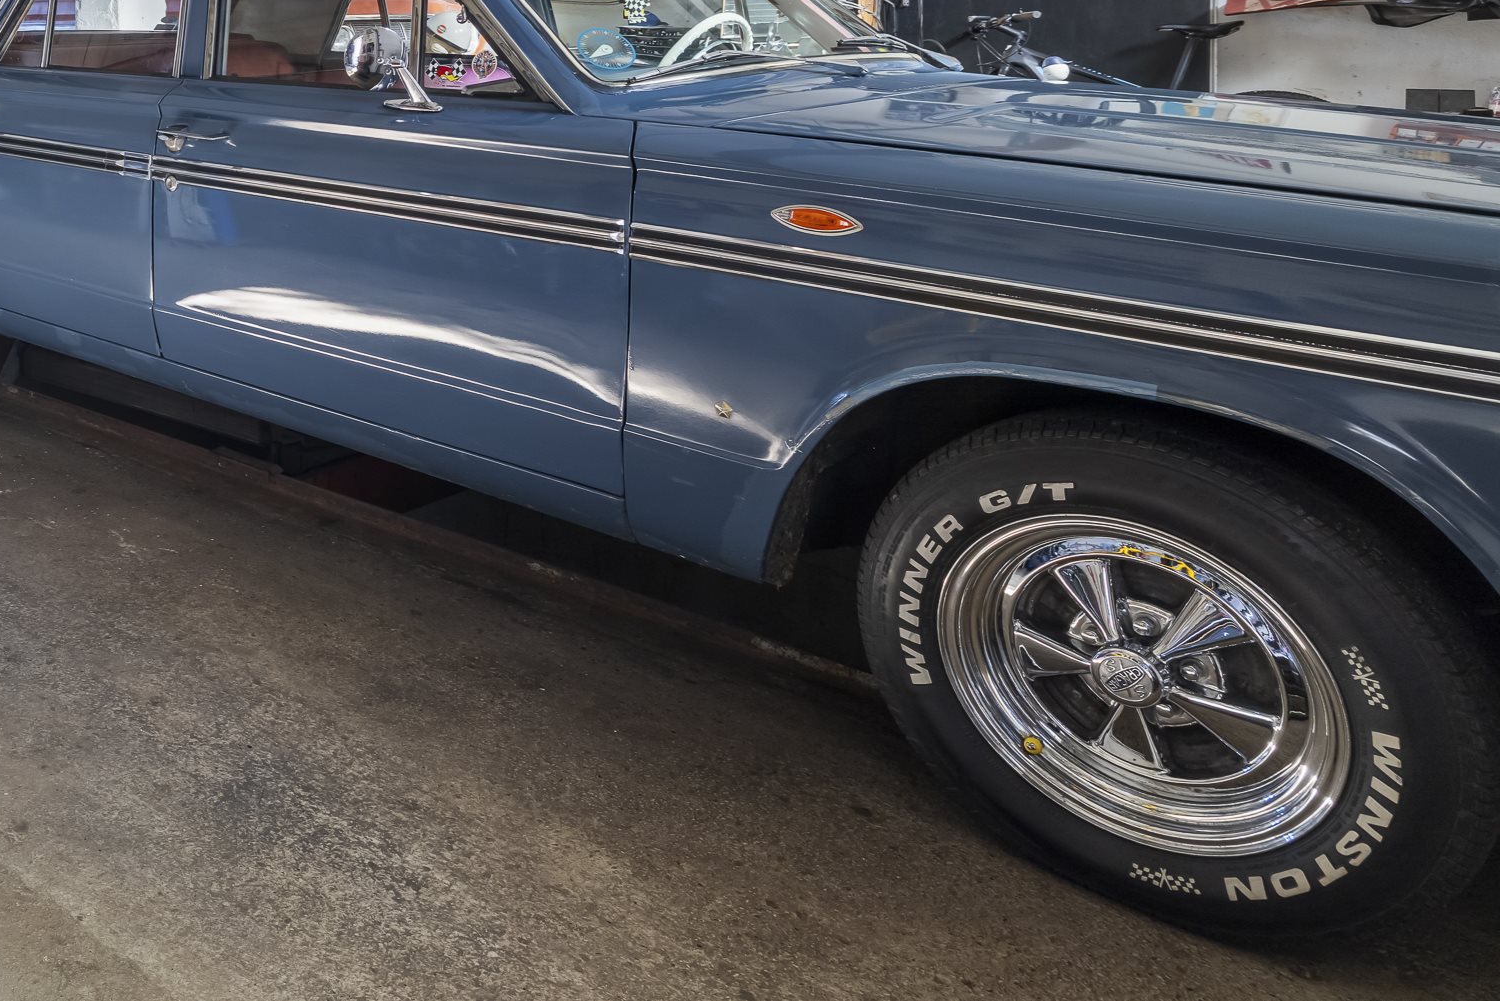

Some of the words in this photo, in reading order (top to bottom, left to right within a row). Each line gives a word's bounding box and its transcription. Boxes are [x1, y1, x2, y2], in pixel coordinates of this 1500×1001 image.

[898, 514, 964, 685] WINNER
[979, 482, 1074, 514] G/T
[1224, 731, 1403, 901] WINSTON
